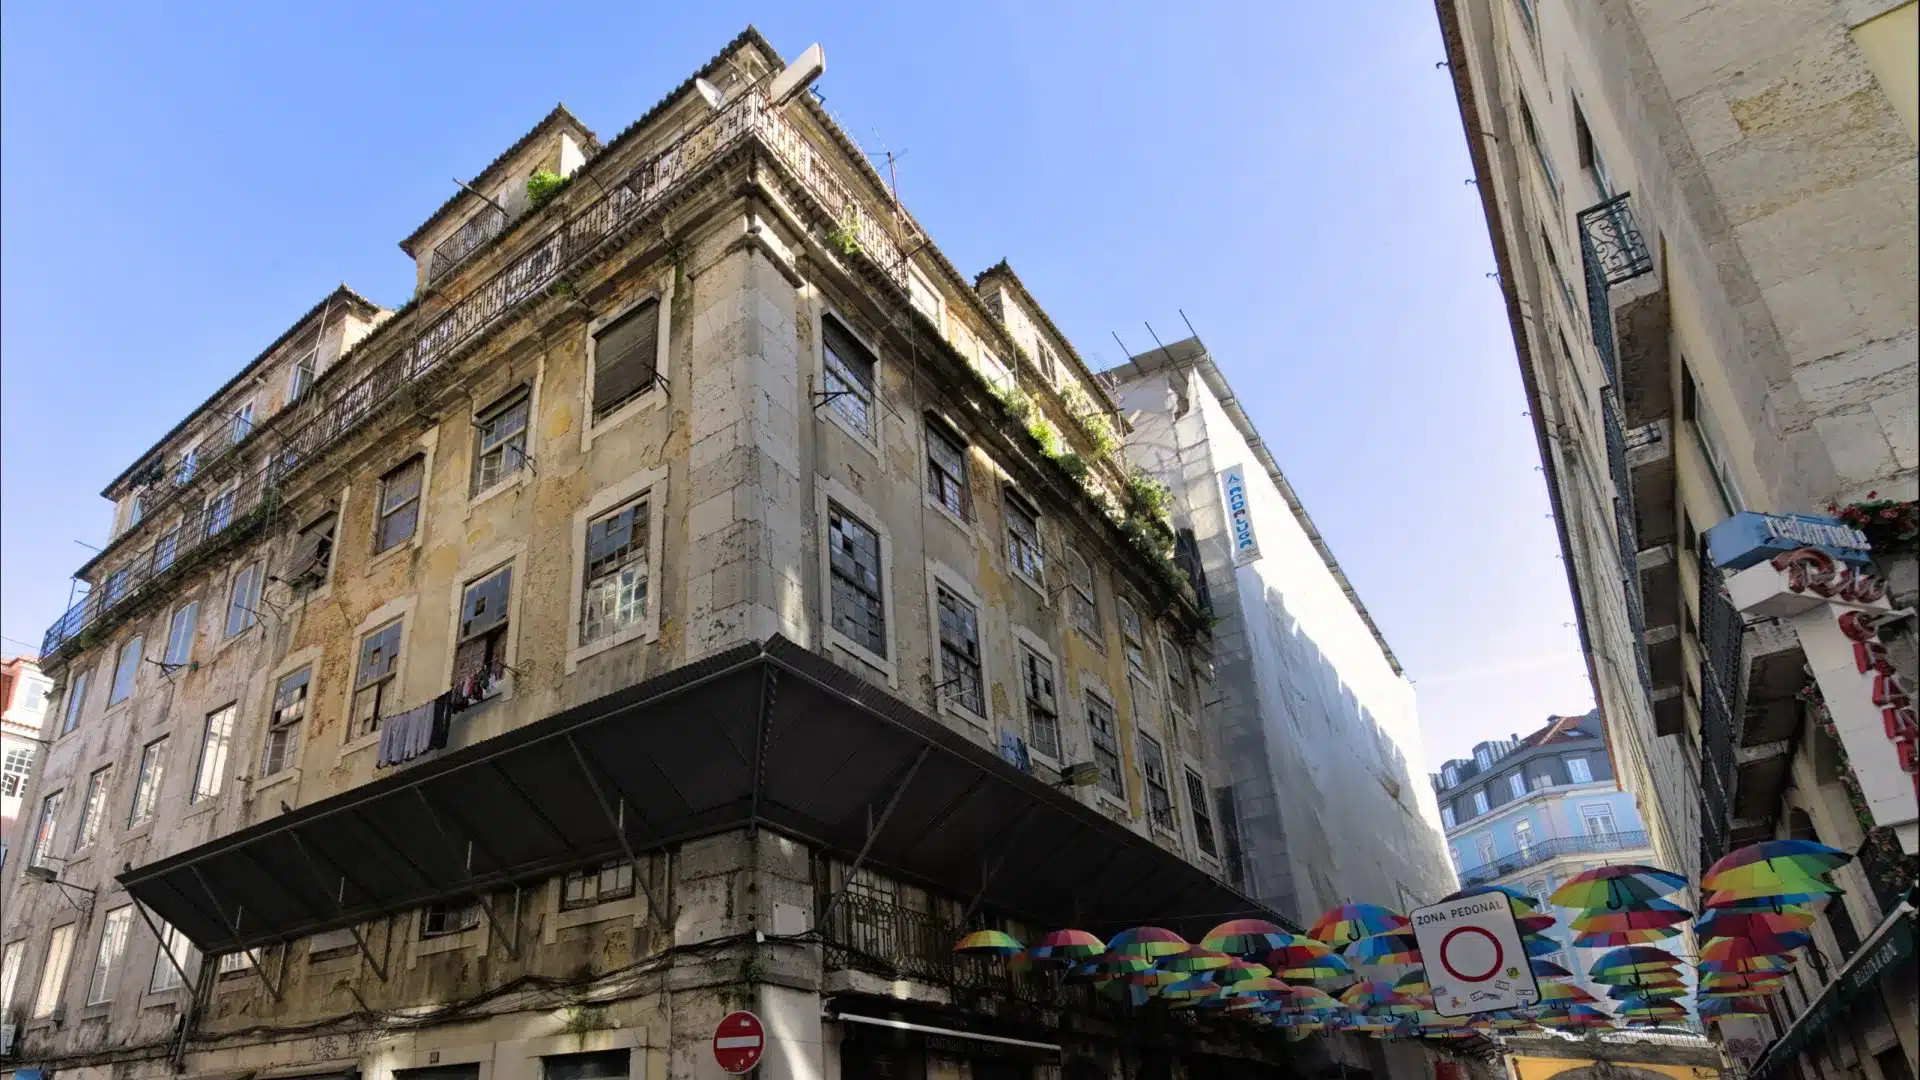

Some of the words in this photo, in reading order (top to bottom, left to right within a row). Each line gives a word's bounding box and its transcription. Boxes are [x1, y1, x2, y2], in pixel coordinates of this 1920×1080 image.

[1838, 611, 1919, 800] GRAN
[1417, 912, 1446, 925] ZONA
[1450, 900, 1504, 919] PEDONAL
